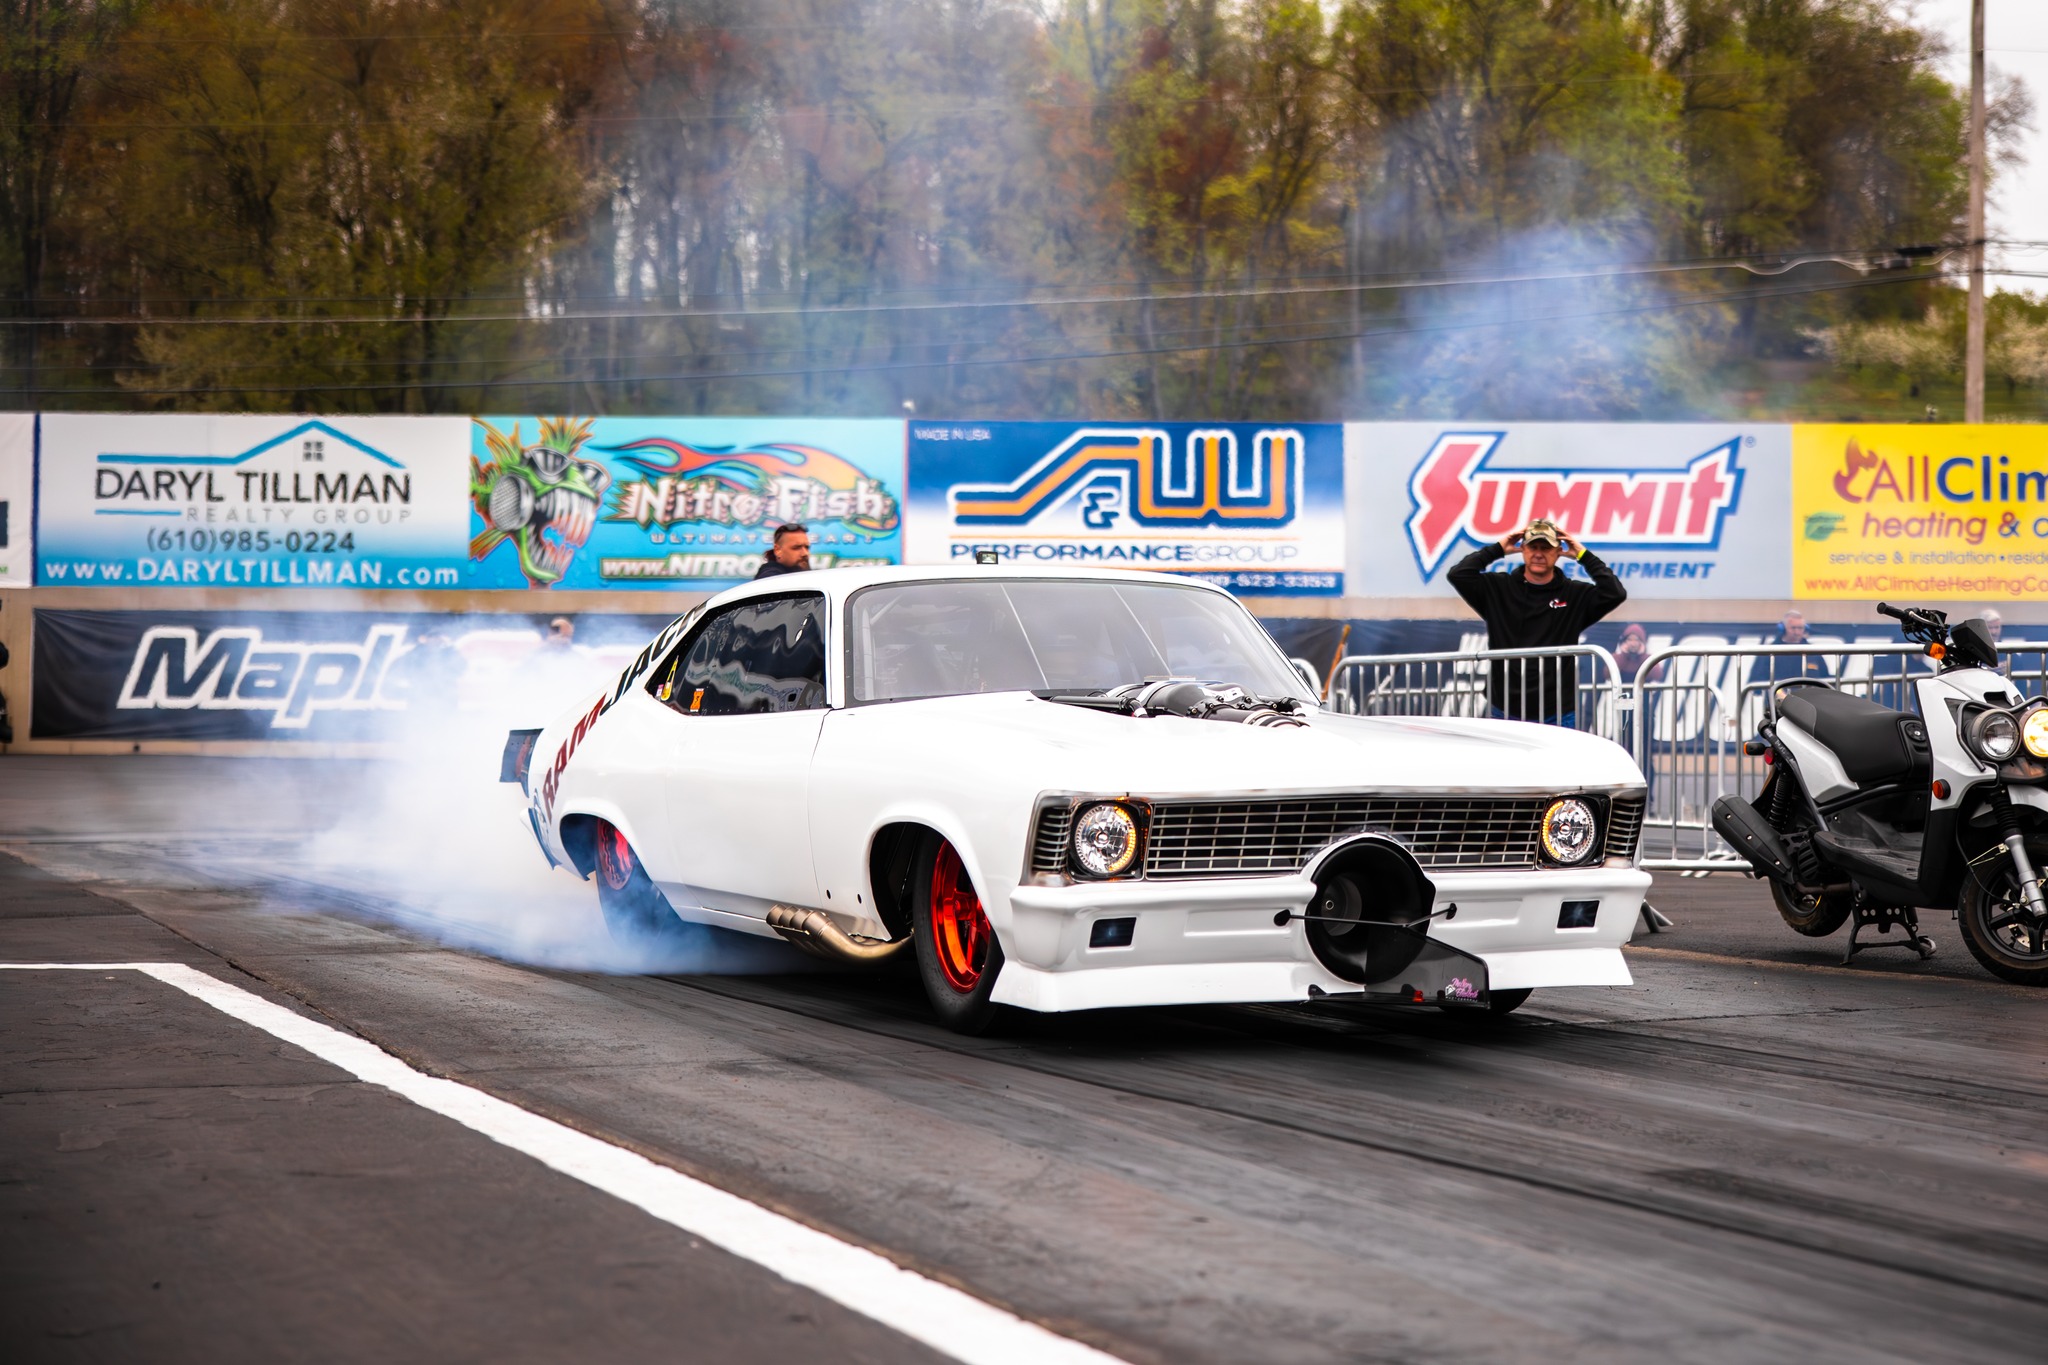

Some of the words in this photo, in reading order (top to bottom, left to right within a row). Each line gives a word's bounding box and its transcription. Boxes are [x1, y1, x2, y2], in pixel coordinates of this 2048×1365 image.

[95, 469, 225, 501] DARYL
[236, 472, 411, 505] TILLMAN
[618, 474, 765, 529] Nitro
[765, 476, 892, 530] Fish
[186, 507, 294, 523] REALTY
[313, 509, 411, 525] GROUP
[1861, 511, 1987, 545] heating
[1997, 511, 2020, 538] &
[147, 528, 355, 553] (610)985-0224
[651, 533, 775, 544] ULTIMATE
[1829, 551, 1887, 564] service
[1893, 551, 1904, 564] &
[1910, 551, 1996, 564] installation
[45, 557, 459, 585] www.DARYLTILLMAN.com
